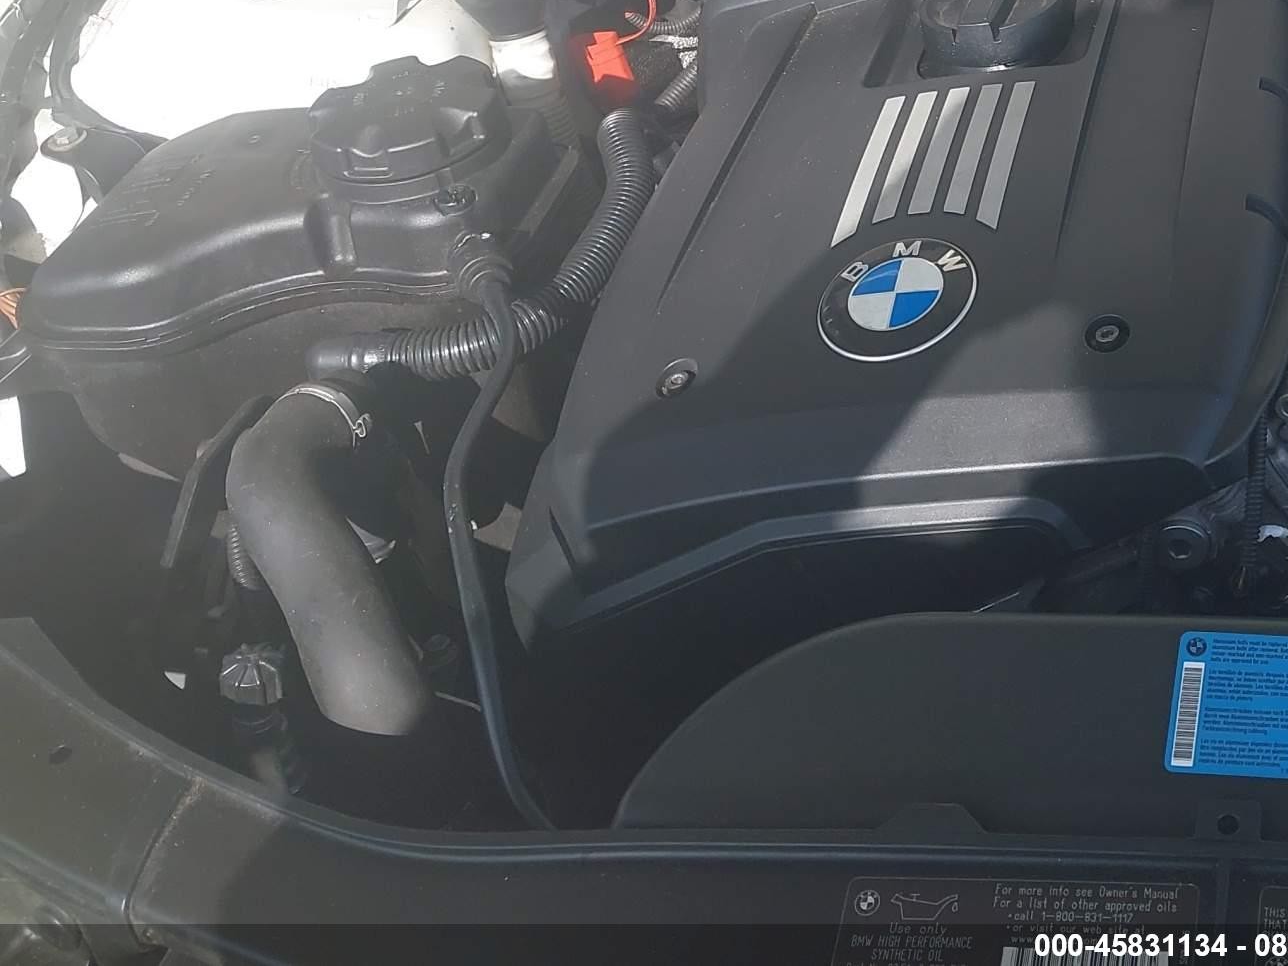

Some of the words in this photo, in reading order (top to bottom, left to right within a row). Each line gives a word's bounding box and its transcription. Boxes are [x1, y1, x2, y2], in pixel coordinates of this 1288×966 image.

[840, 240, 967, 283] BMW
[995, 883, 1012, 896] For
[1018, 887, 1043, 897] more
[1049, 884, 1070, 897] info
[1075, 888, 1093, 898] see
[1099, 885, 1138, 899] Owner's
[1143, 887, 1179, 900] Manual
[993, 896, 1011, 908] For
[1016, 900, 1023, 909] a
[1029, 897, 1047, 909] list
[1053, 898, 1066, 911] of
[1071, 898, 1099, 911] other
[1104, 900, 1152, 912] approved
[1156, 900, 1177, 912] oils
[1013, 911, 1034, 921] call
[1264, 907, 1286, 918] THIS
[889, 922, 911, 934] Use
[919, 923, 947, 937] only
[851, 934, 874, 946] BMW
[878, 935, 901, 947] HIGH
[905, 935, 973, 949] PERFORMANCE
[871, 948, 923, 961] SYNTHETIC
[928, 949, 944, 962] OIL
